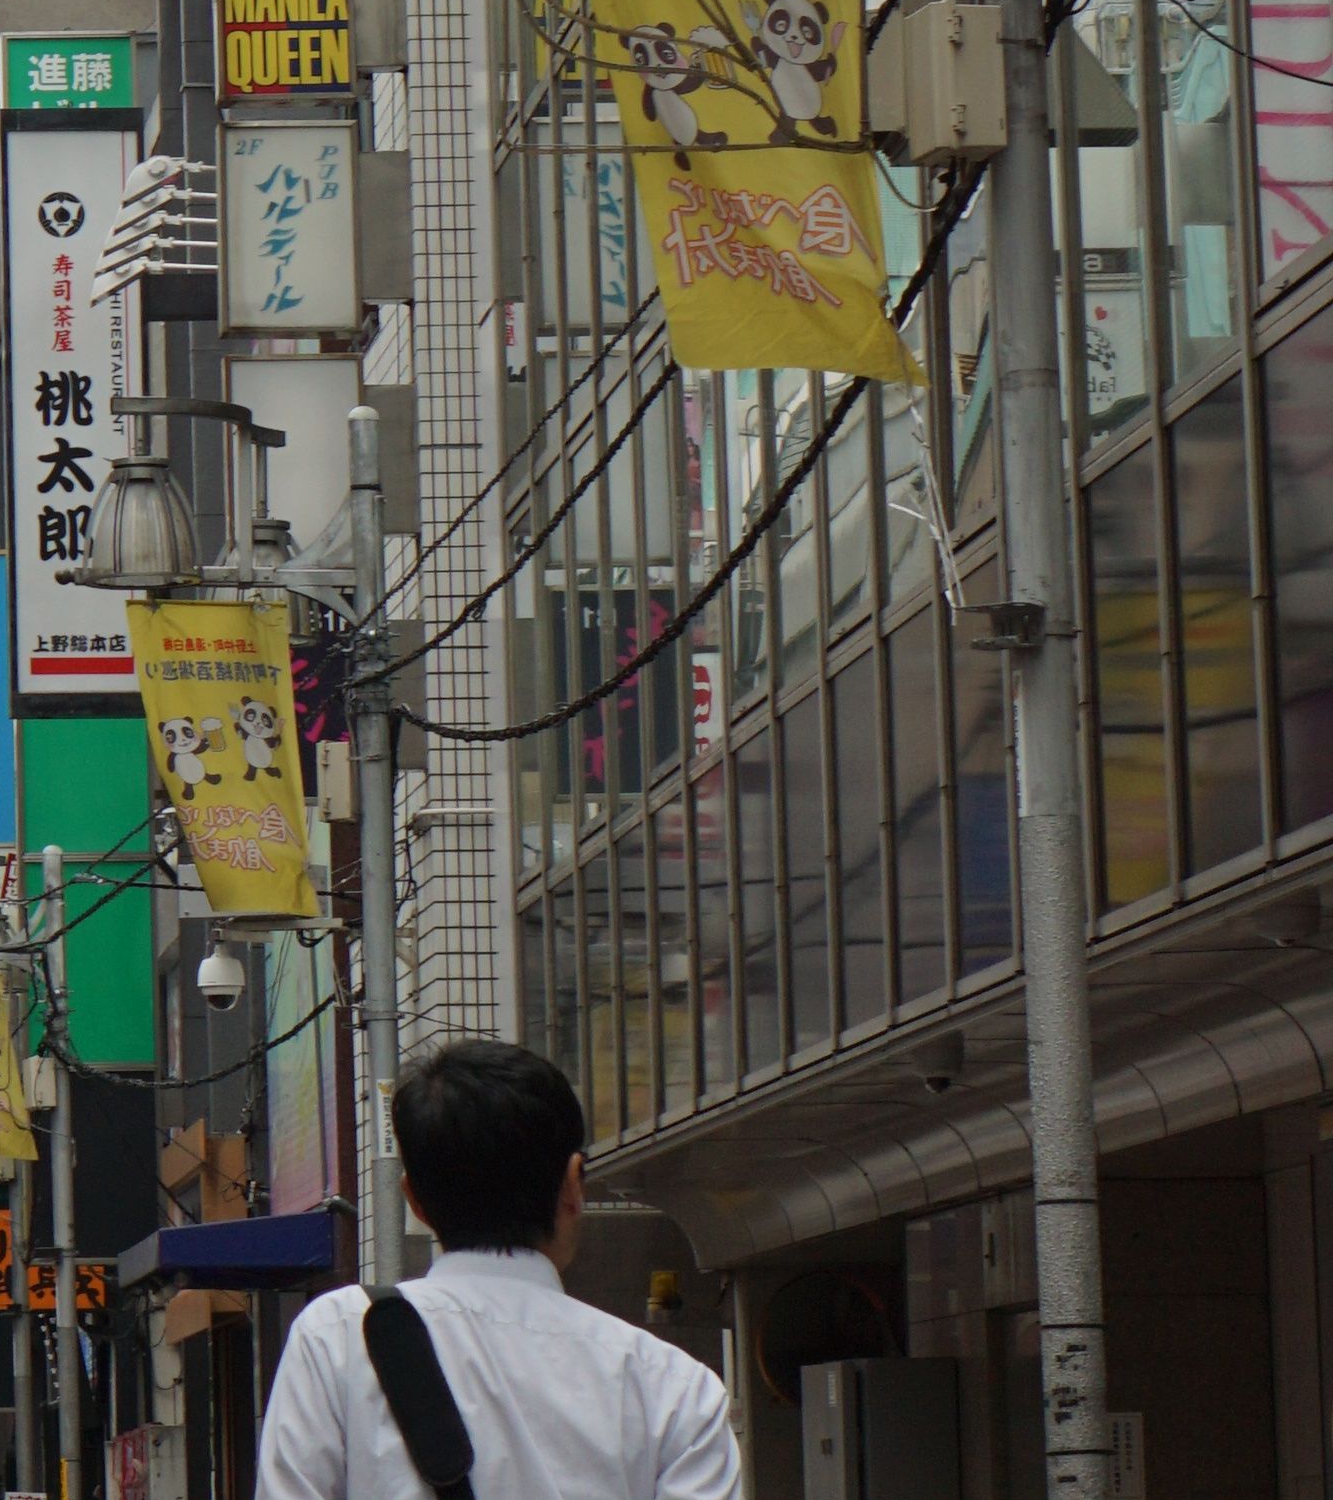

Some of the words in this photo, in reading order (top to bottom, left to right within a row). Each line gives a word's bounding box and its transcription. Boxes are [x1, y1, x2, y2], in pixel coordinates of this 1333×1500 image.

[28, 52, 113, 93] 進藤
[224, 29, 350, 96] QUEEN
[234, 138, 264, 157] 2F
[51, 252, 75, 354] 寿司茶屋
[34, 369, 94, 563] 桃太郎
[33, 633, 127, 655] 上野総本店
